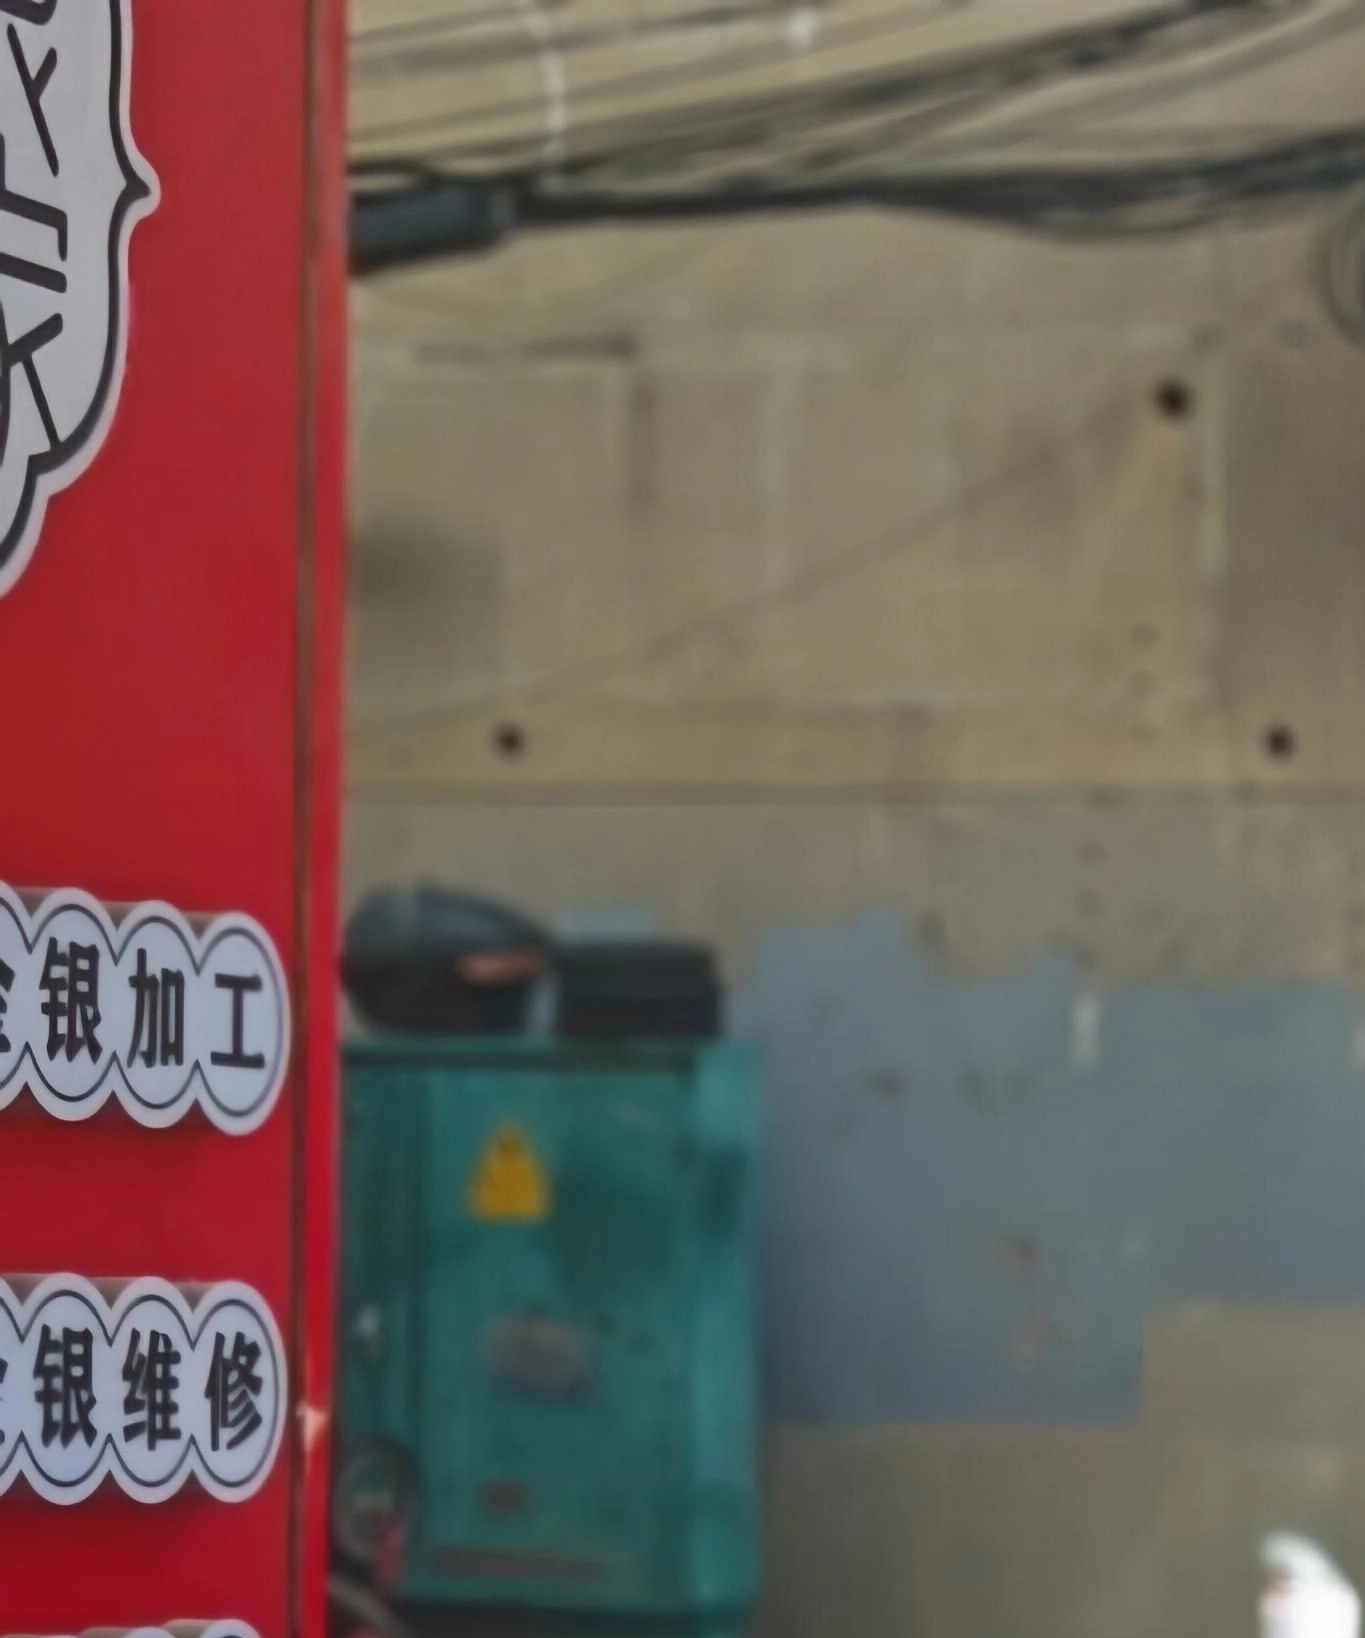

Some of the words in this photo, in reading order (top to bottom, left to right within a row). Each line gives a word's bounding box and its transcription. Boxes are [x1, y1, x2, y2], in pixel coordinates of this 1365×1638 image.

[0, 937, 266, 1069] 银加工
[0, 1323, 264, 1452] 银维修
